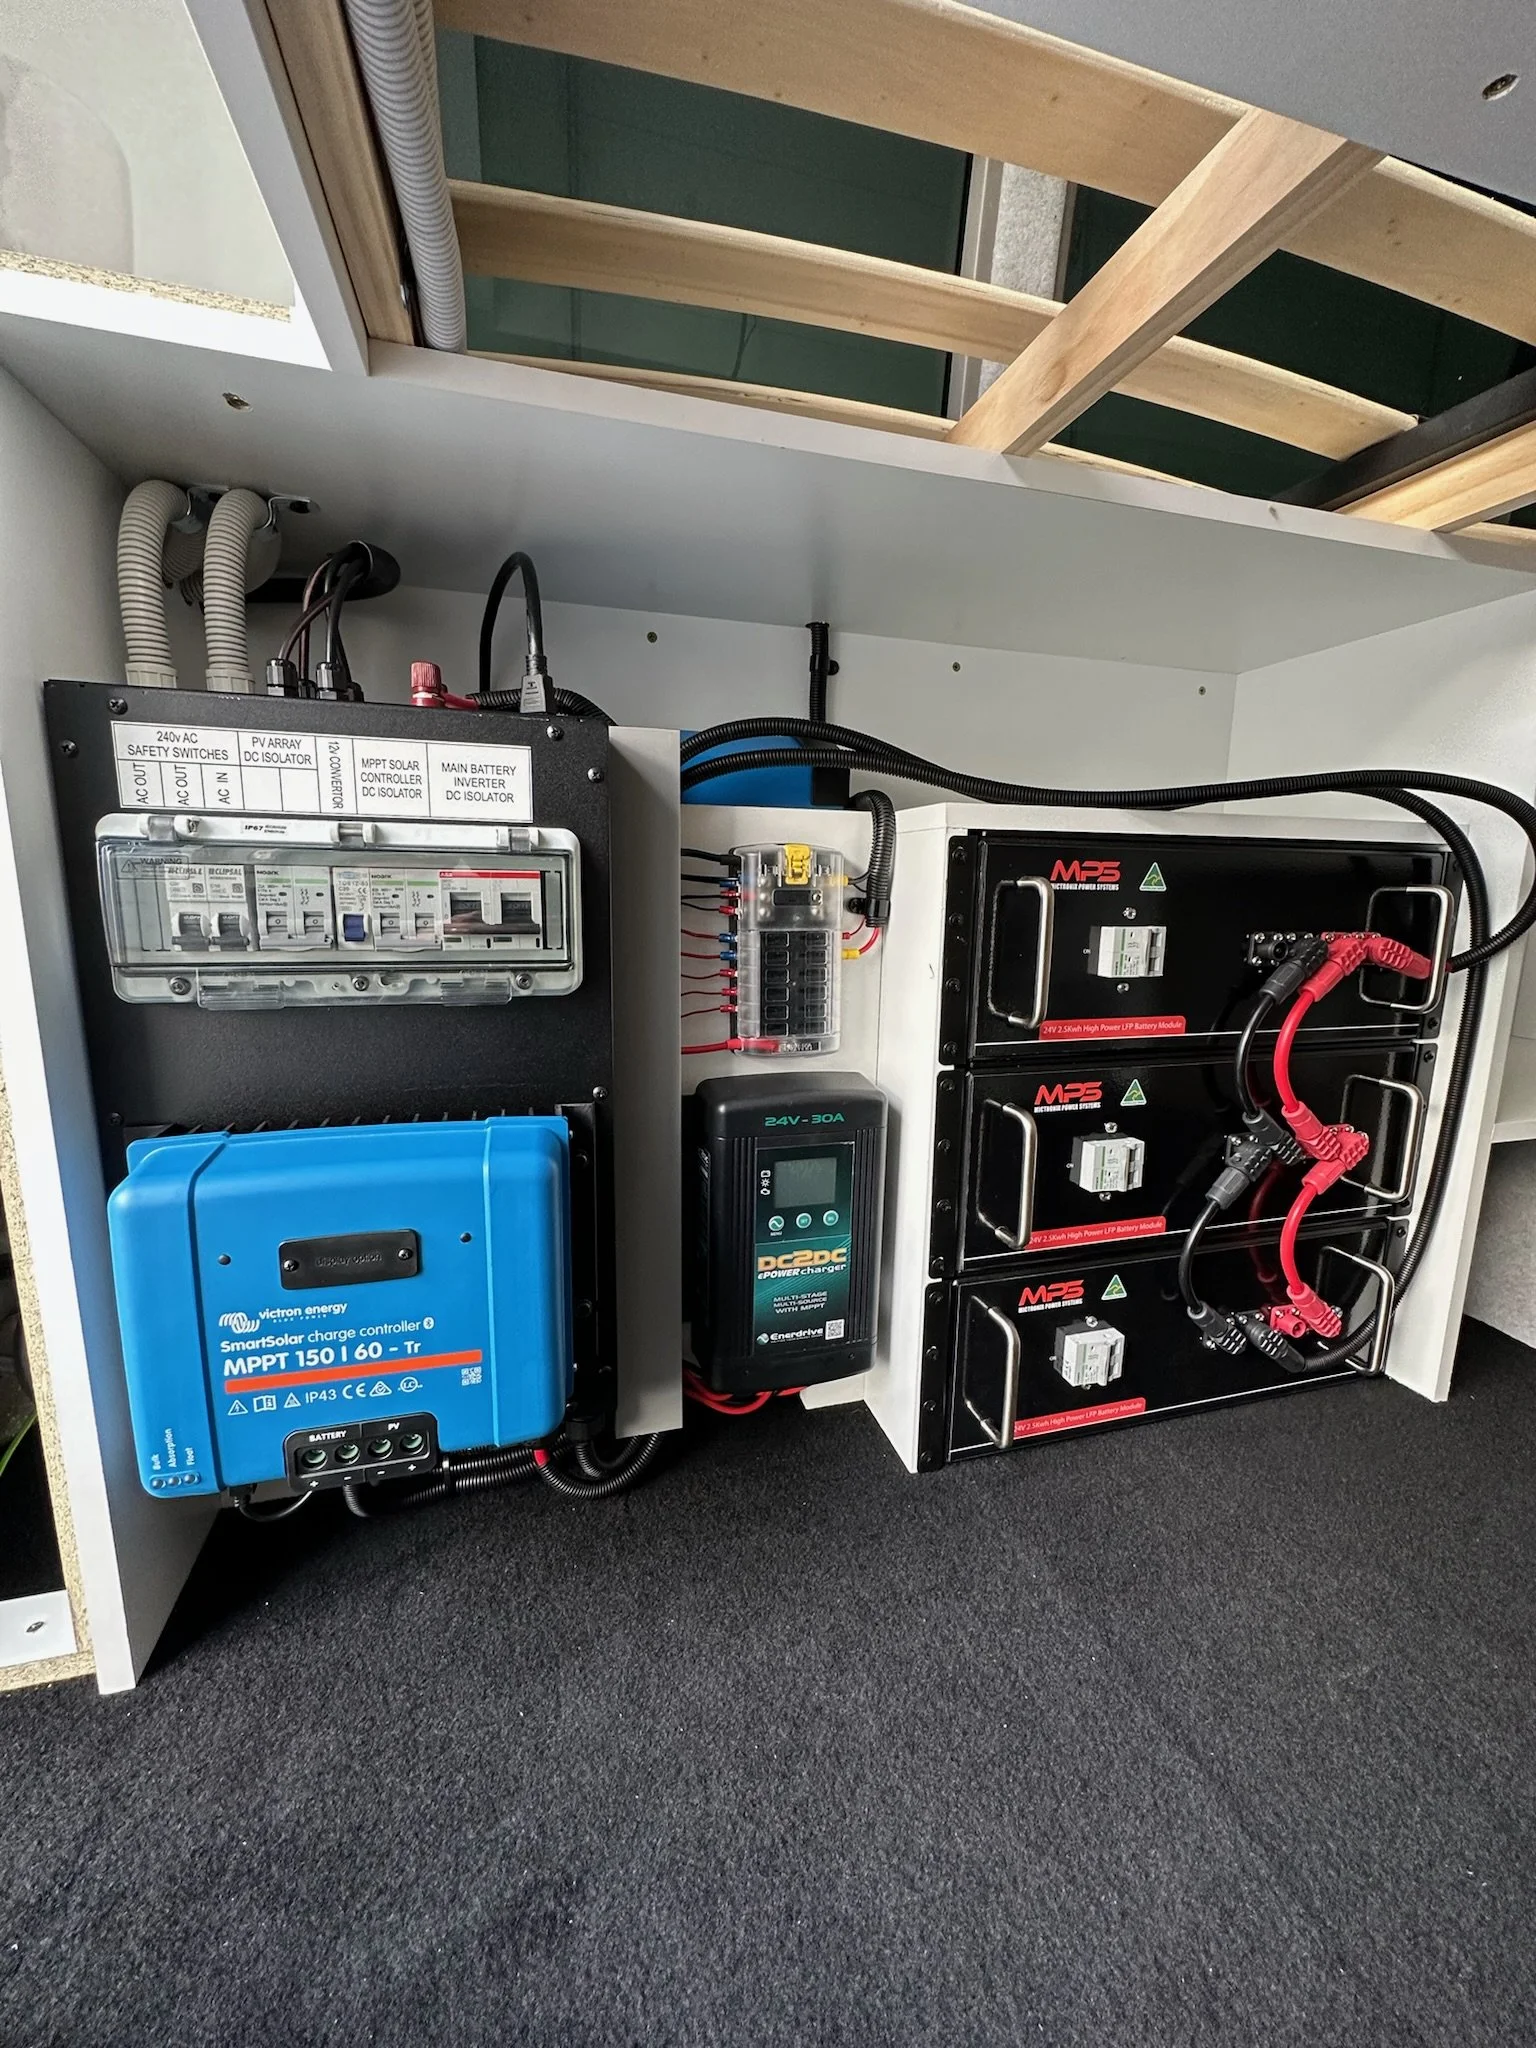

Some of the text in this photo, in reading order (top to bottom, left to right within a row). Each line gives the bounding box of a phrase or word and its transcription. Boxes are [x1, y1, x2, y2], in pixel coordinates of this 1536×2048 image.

[156, 730, 198, 744] 240v AC
[252, 736, 301, 749] PV ARRAY
[128, 744, 229, 761] SAFETY SWITCHES
[244, 751, 312, 765] DC ISOLATOR
[362, 758, 420, 771] MPPT SOLAR
[441, 762, 517, 776] MAIN BATTERY
[328, 740, 343, 809] 12v CONVERTOR
[360, 772, 422, 785] CONTROLLER
[133, 762, 148, 804] AC OUT
[174, 764, 189, 805] AC OUT
[217, 772, 230, 804] AC IN
[454, 777, 506, 789] INVERTER
[362, 786, 422, 799] DC ISOLATOR
[446, 790, 514, 803] DC ISOLATOR
[1050, 860, 1120, 882] MPS
[1083, 1024, 1099, 1034] High
[1134, 1022, 1158, 1032] Battery
[1034, 1081, 1102, 1106] MPS
[1061, 1103, 1078, 1111] POWER
[1079, 1102, 1101, 1110] SYSTEMS
[764, 1116, 800, 1126] 24V
[811, 1113, 844, 1124] 30A
[1067, 1231, 1083, 1241] High
[1084, 1229, 1103, 1237] Power
[1104, 1227, 1116, 1235] LFP
[1117, 1224, 1139, 1234] Battery
[1140, 1221, 1163, 1230] Module
[758, 1247, 847, 1272] DC2DC
[773, 1291, 828, 1302] MULTI-STAGE
[1018, 1280, 1084, 1306] MPS
[773, 1296, 828, 1308] MULTI-SOURCE
[800, 1302, 825, 1311] MPPT
[1045, 1302, 1061, 1310] POWER
[1062, 1298, 1083, 1307] SYSTEMS
[259, 1303, 348, 1320] victron energy
[220, 1320, 420, 1352] SmartSolar charge controller
[770, 1328, 824, 1340] Enerdrive
[224, 1352, 289, 1376] MPPT
[295, 1348, 335, 1368] 150
[354, 1342, 382, 1360] 60
[404, 1341, 421, 1354] Tr
[305, 1389, 337, 1404] IP43
[1050, 1418, 1065, 1427] High
[1066, 1414, 1085, 1423] Power
[1098, 1407, 1119, 1416] Battery
[1119, 1402, 1142, 1412] Module
[388, 1422, 400, 1431] PV
[309, 1430, 346, 1442] BATTERY
[167, 1428, 177, 1468] Absorption
[186, 1447, 195, 1465] Float
